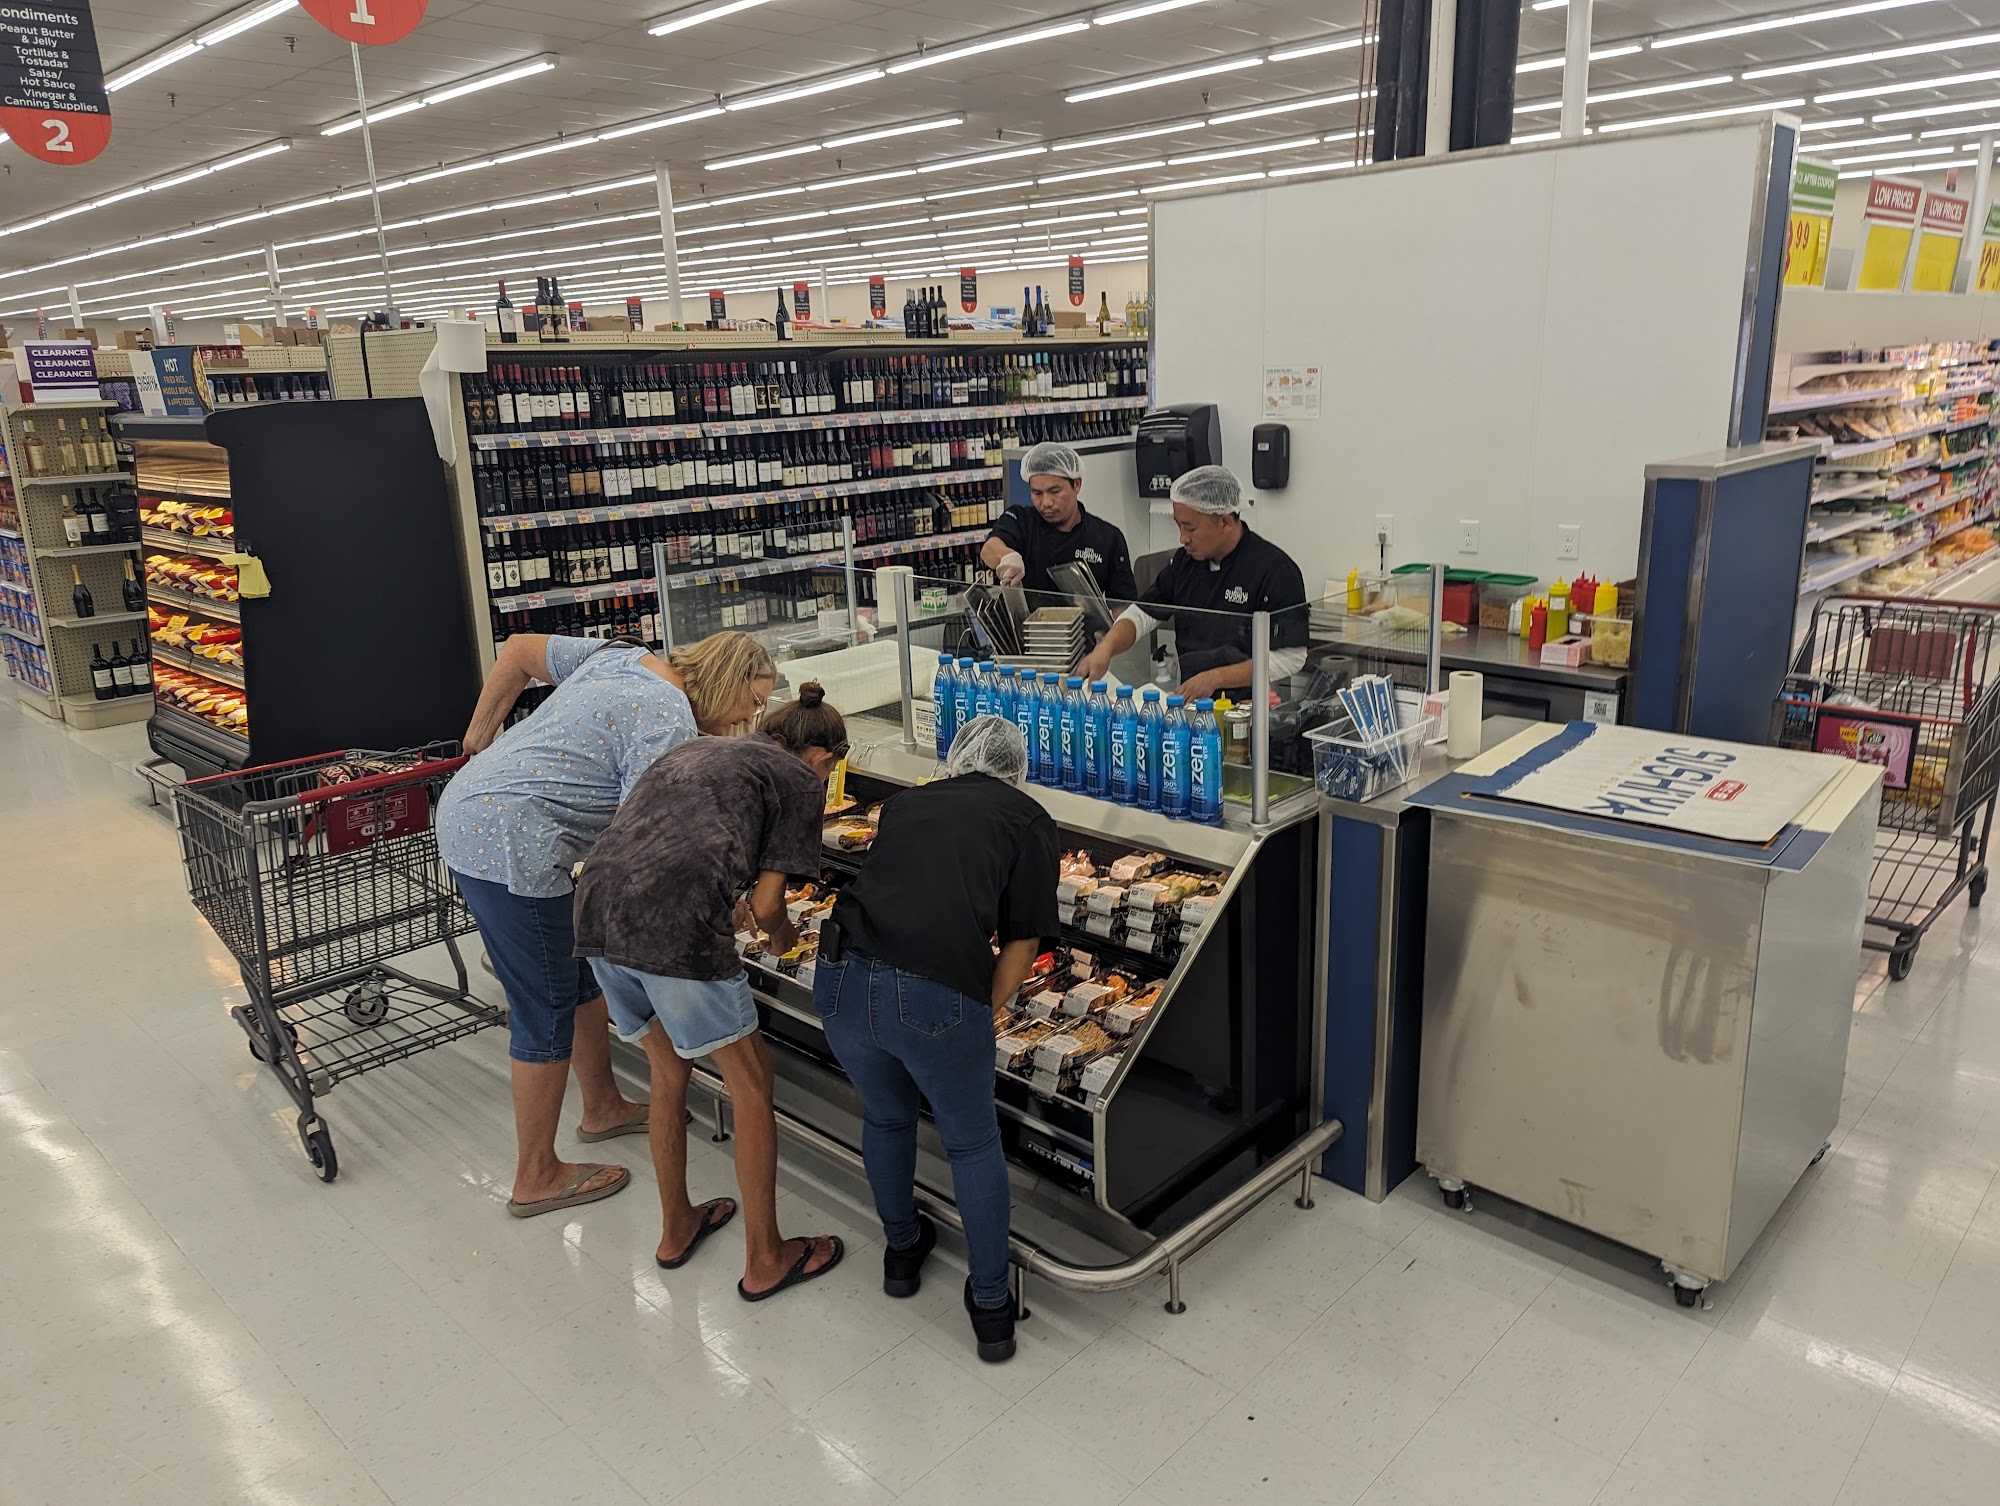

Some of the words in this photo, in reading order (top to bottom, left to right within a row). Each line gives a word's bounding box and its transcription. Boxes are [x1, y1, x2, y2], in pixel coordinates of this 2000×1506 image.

[0, 7, 79, 25] ondiments
[0, 23, 38, 35] Peanut
[41, 28, 75, 39] Butter
[22, 35, 29, 43] &
[33, 37, 57, 48] Jelly
[14, 46, 58, 59] Tortillas
[62, 51, 69, 59] &
[18, 56, 68, 68] Tostadas
[29, 69, 62, 80] Salsa/
[20, 77, 40, 86] Hot
[44, 80, 75, 89] Sauce
[23, 88, 66, 100] Vinegar
[69, 93, 76, 101] &
[5, 96, 50, 109] Canning
[53, 100, 98, 112] Supplies
[42, 119, 73, 152] 2
[1874, 185, 1892, 206] LOW
[1891, 189, 1915, 209] PRICES
[1929, 199, 1944, 216] LOW
[1943, 202, 1963, 221] PRICES
[1074, 296, 1080, 304] 6
[31, 349, 89, 357] CLEARANCE!
[33, 359, 91, 368] CLEARANCE!
[163, 358, 179, 372] HOT
[36, 370, 93, 378] CLEARANCE!
[164, 375, 176, 384] FRIED
[162, 387, 178, 395] NOODLE
[1039, 716, 1050, 751] zen
[1061, 720, 1071, 755] zen
[1084, 723, 1094, 760] zen
[1112, 730, 1124, 767] zen
[1136, 733, 1146, 772] zen
[1163, 740, 1176, 779] zen
[1191, 745, 1204, 784] zen
[1583, 747, 1736, 816] SUSHIYA
